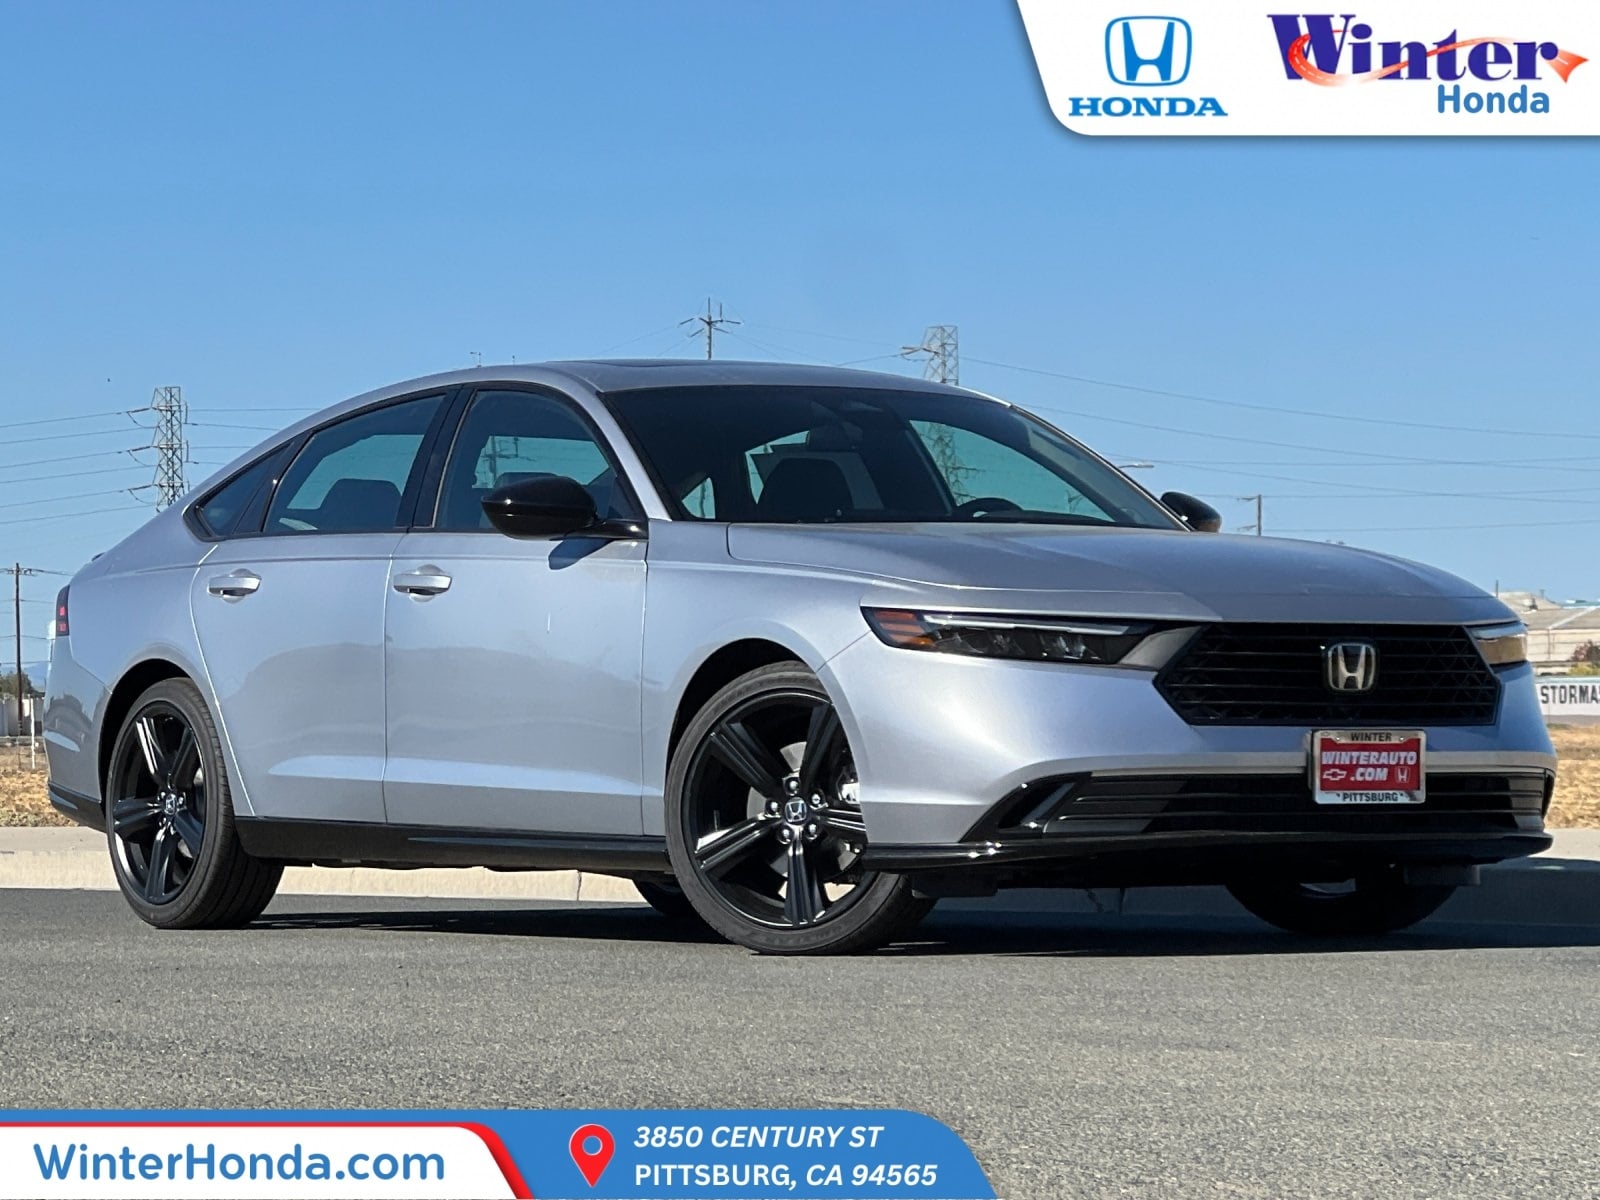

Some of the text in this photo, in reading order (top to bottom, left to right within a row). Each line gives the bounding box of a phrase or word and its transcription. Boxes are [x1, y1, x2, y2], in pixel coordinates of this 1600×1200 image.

[1541, 684, 1600, 704] STORMA
[1351, 732, 1392, 742] WINTER
[1321, 751, 1417, 765] WINTERAUTO
[1350, 767, 1388, 781] .COM
[1342, 792, 1399, 802] PITTSBURG
